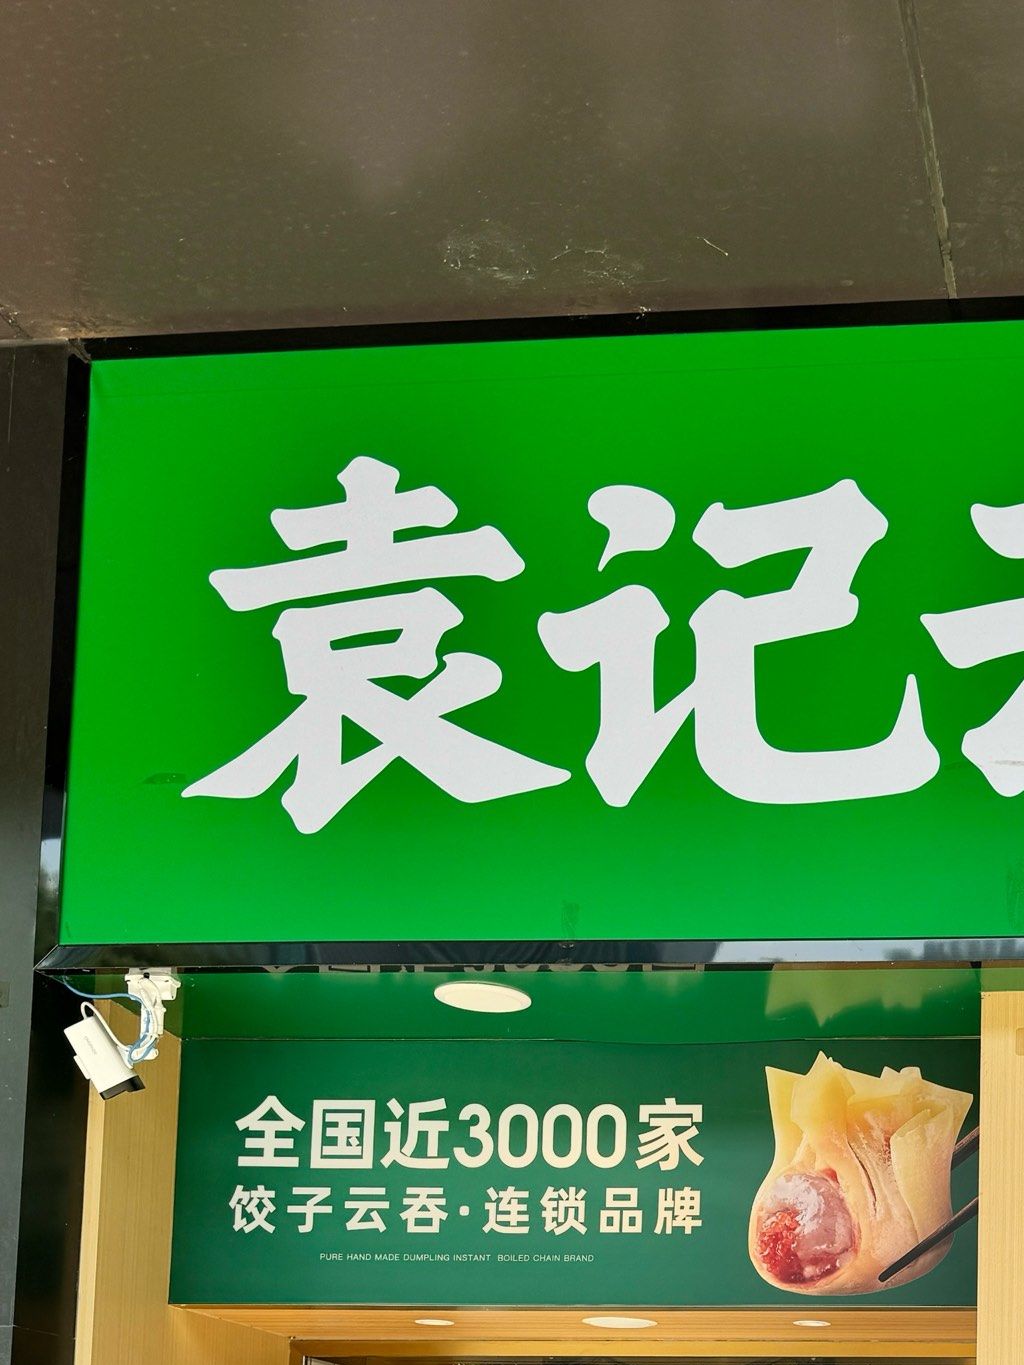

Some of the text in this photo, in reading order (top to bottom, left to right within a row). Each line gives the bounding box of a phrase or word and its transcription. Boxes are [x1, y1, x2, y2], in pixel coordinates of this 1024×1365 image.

[234, 1095, 705, 1171] 全国近3000家
[319, 1253, 594, 1262] PURE HAND MADE DUMPLING INSTANT BOILED CHAIN BRAND
